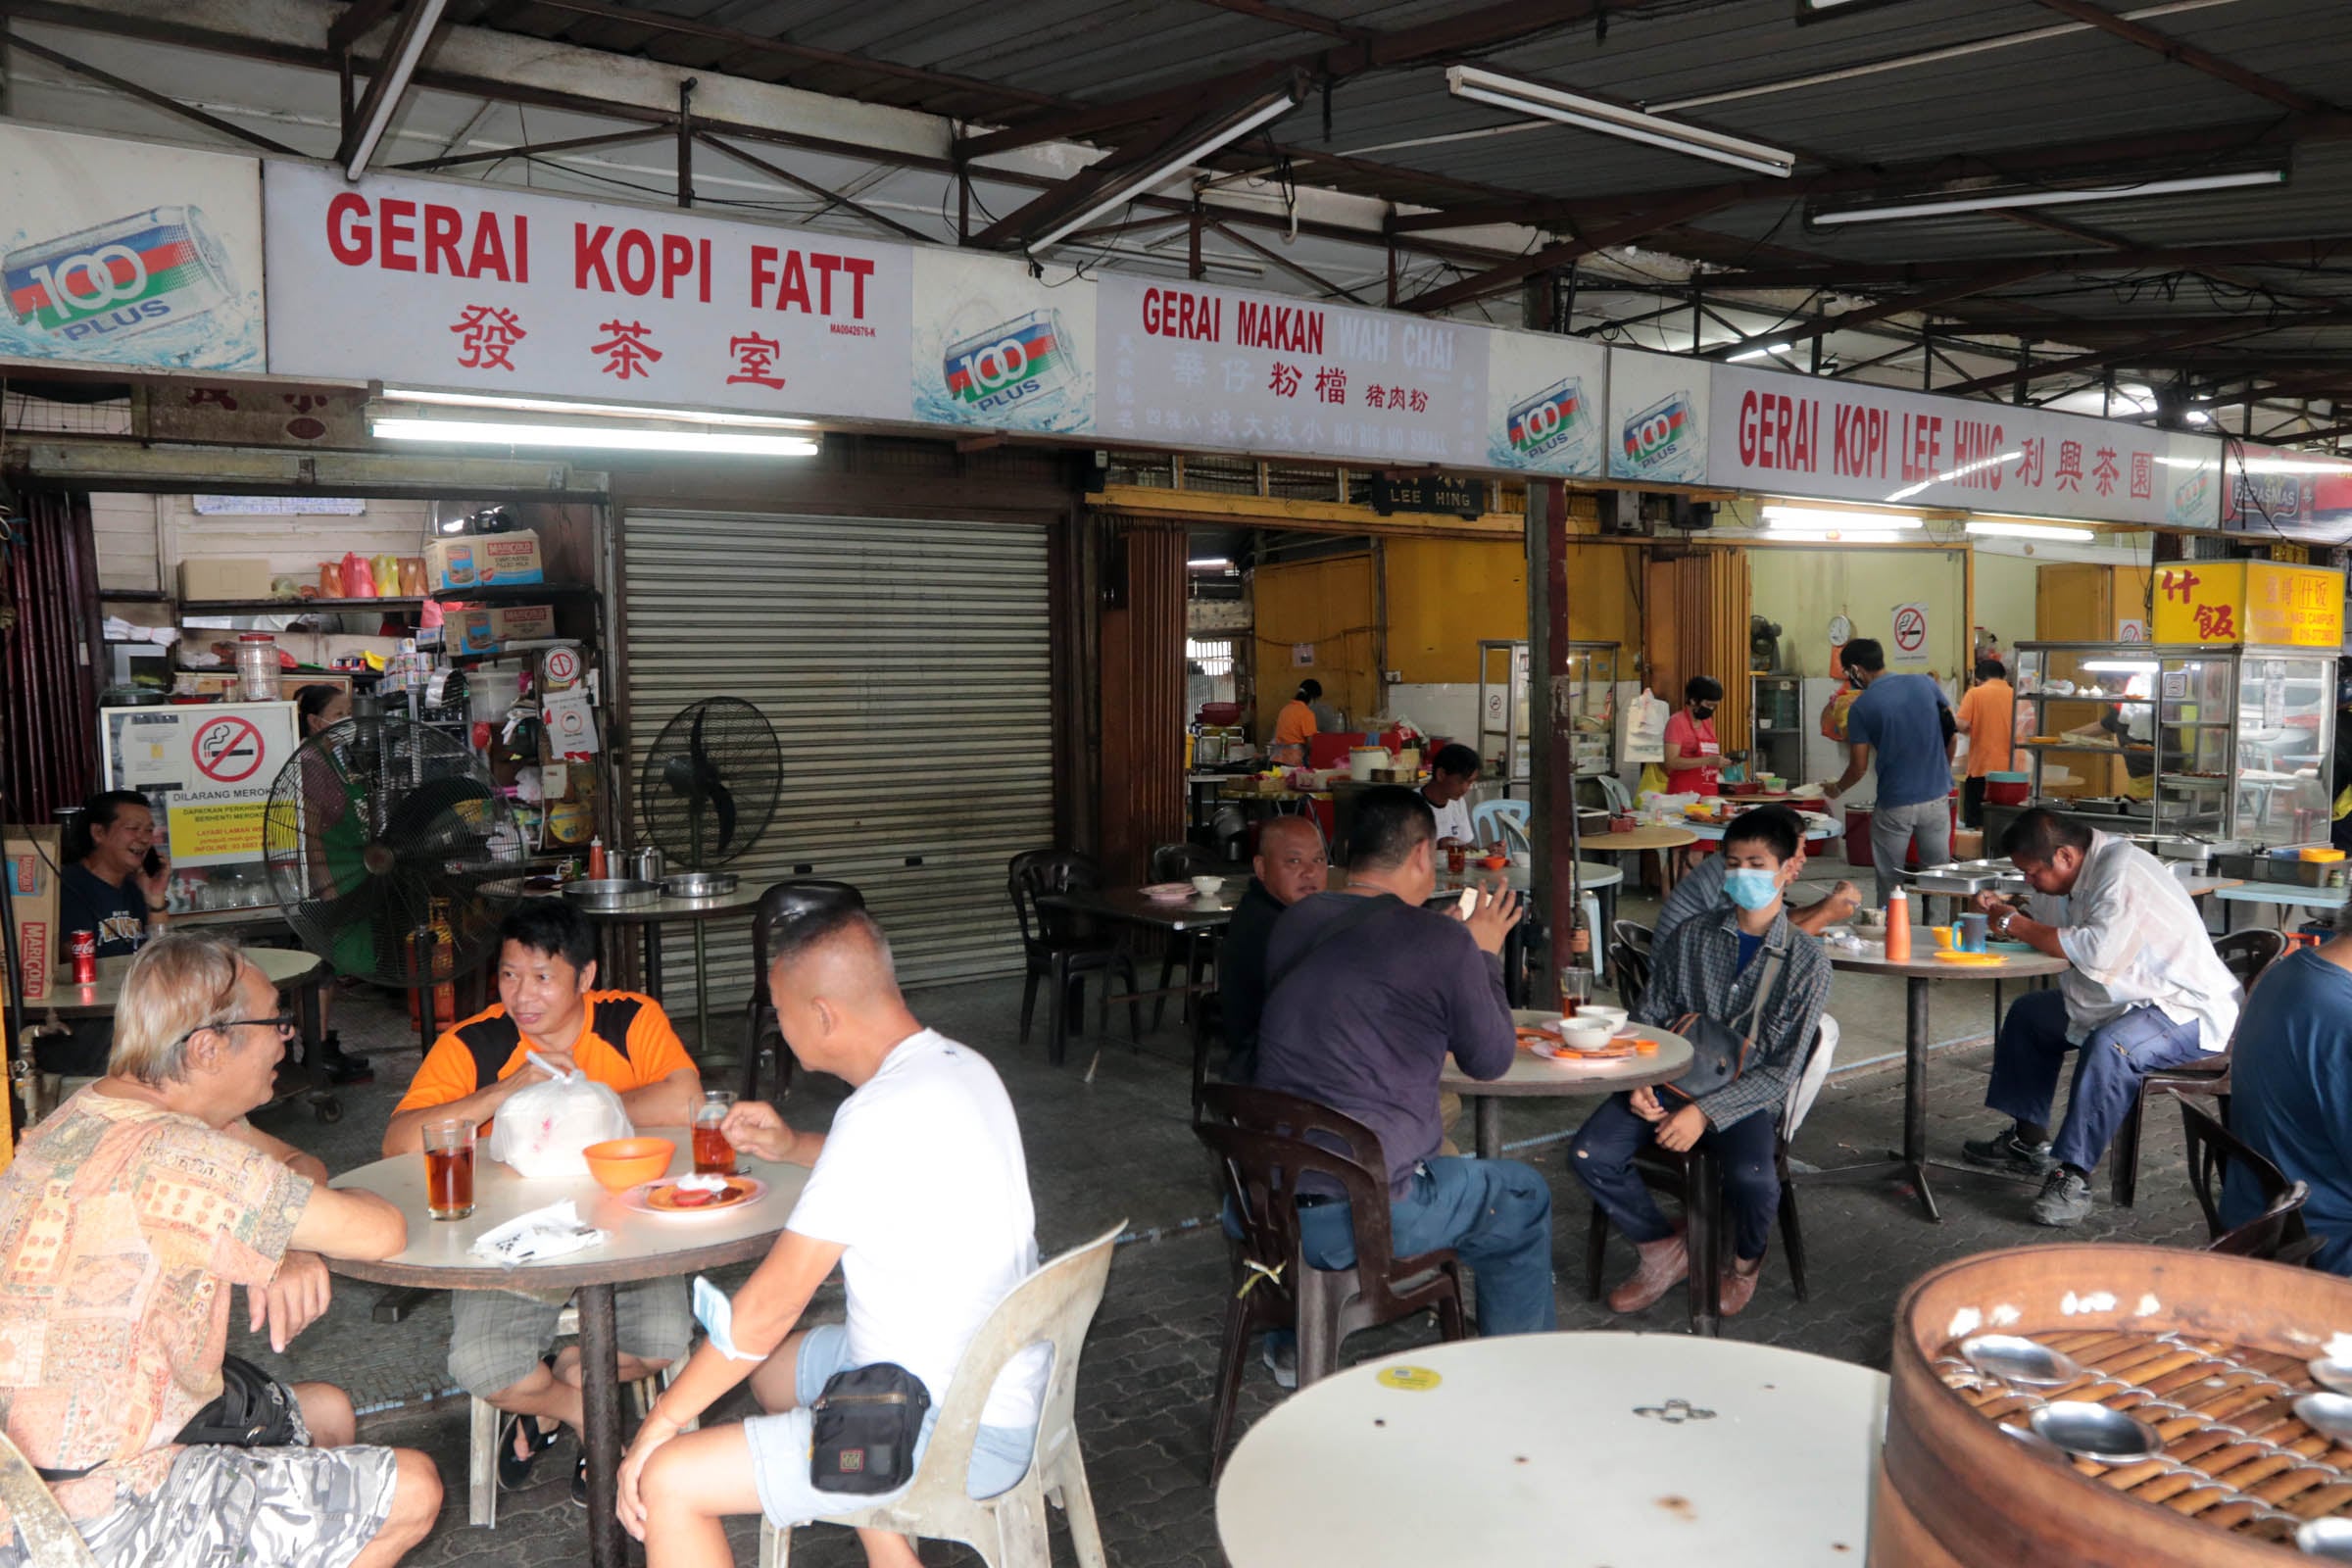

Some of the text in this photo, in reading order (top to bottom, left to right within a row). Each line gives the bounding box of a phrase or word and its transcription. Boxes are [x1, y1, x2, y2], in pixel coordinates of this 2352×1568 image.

[326, 192, 875, 319] GERAI KOPI FATT
[29, 243, 147, 320] 100
[62, 299, 172, 341] PLUS
[1143, 287, 1456, 373] GERAI MAKAN WAH CHAI
[960, 338, 1029, 396] 100
[979, 379, 1042, 412] PLUS
[1517, 400, 1561, 447] 100
[1633, 414, 1672, 452] 100
[1739, 390, 2004, 492] GERAI KOPI LEE HING
[1529, 433, 1568, 459] PLUS
[1642, 444, 1678, 468] PLUS
[1390, 488, 1471, 507] LEE HING
[173, 790, 230, 802] DILARANG
[24, 924, 44, 995] MARIGOLD
